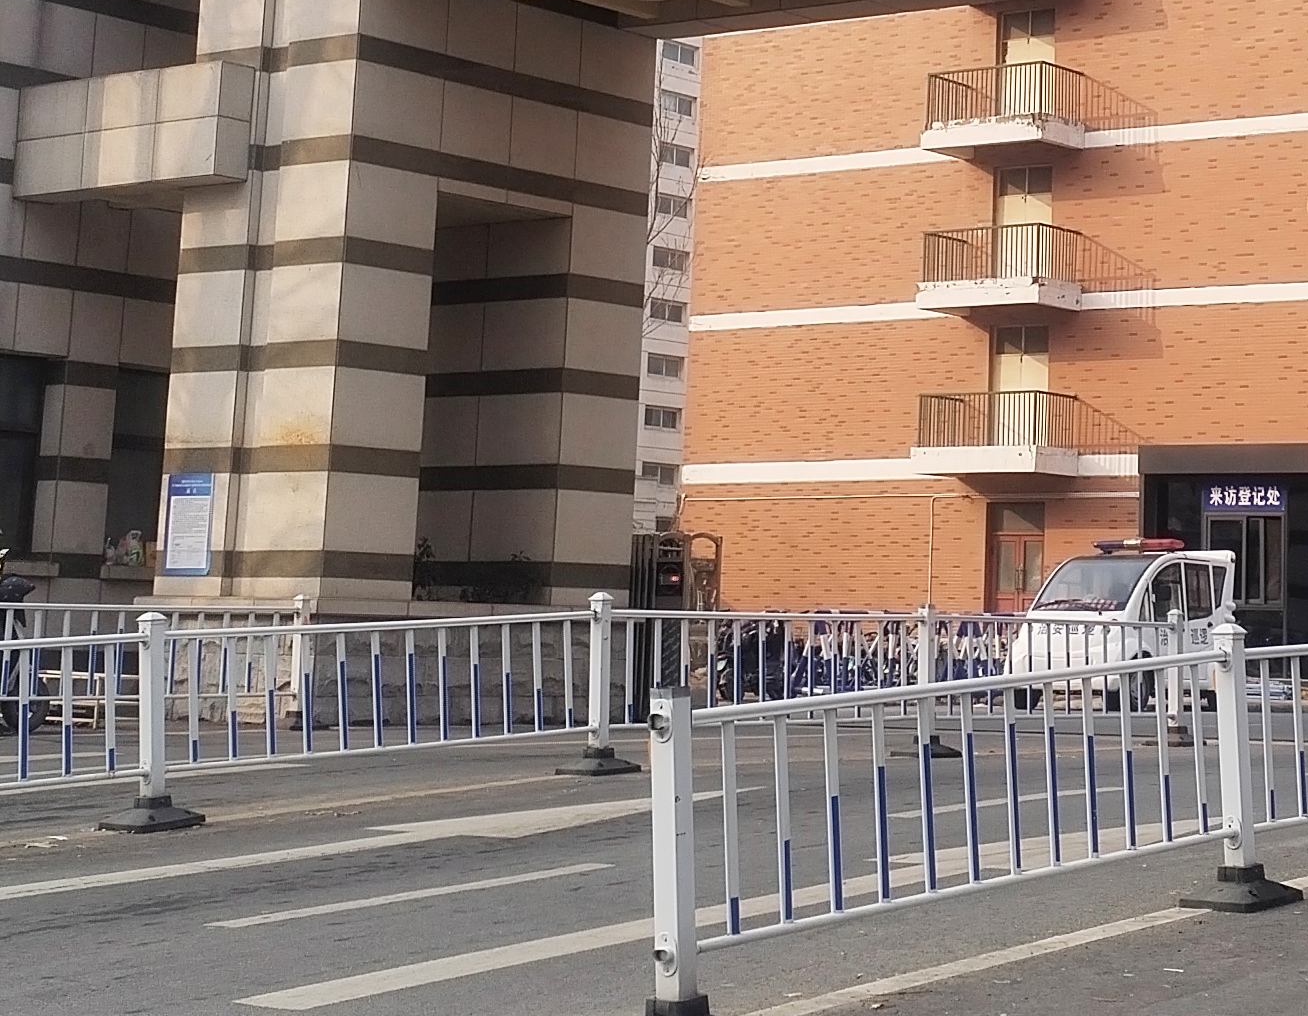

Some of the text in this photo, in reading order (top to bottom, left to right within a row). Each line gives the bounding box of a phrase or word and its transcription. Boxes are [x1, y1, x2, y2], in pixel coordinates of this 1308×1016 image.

[1209, 485, 1281, 506] 来访登记处
